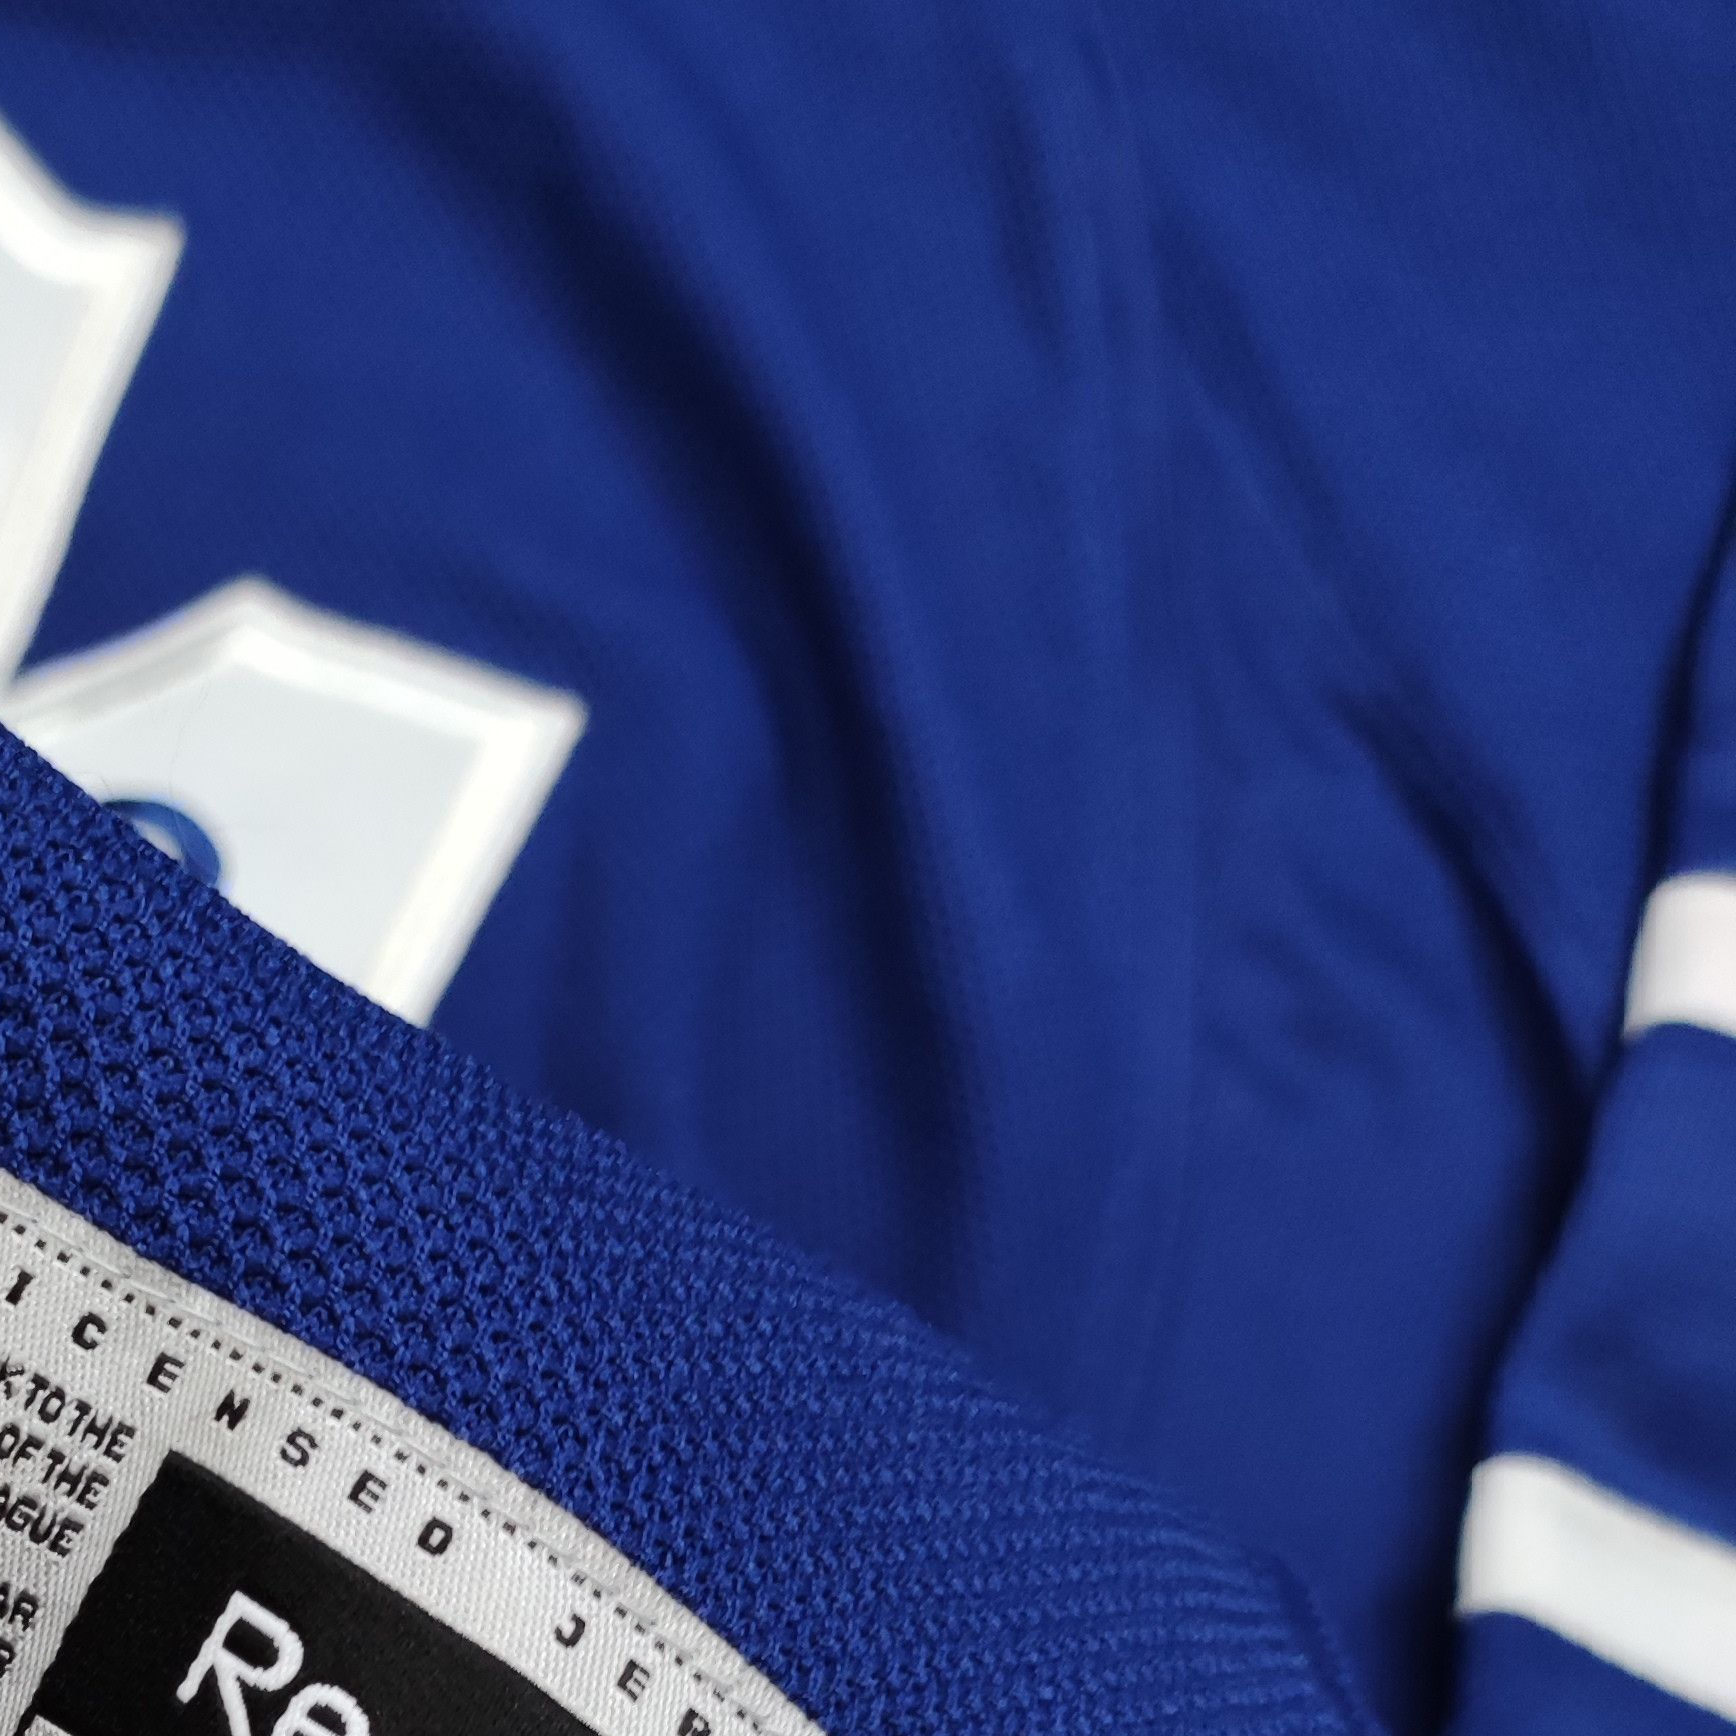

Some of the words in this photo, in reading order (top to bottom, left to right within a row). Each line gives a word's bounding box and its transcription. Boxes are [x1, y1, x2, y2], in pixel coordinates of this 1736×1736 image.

[26, 1375, 68, 1425] TO
[61, 1396, 135, 1463] THE
[37, 1445, 111, 1512] THE
